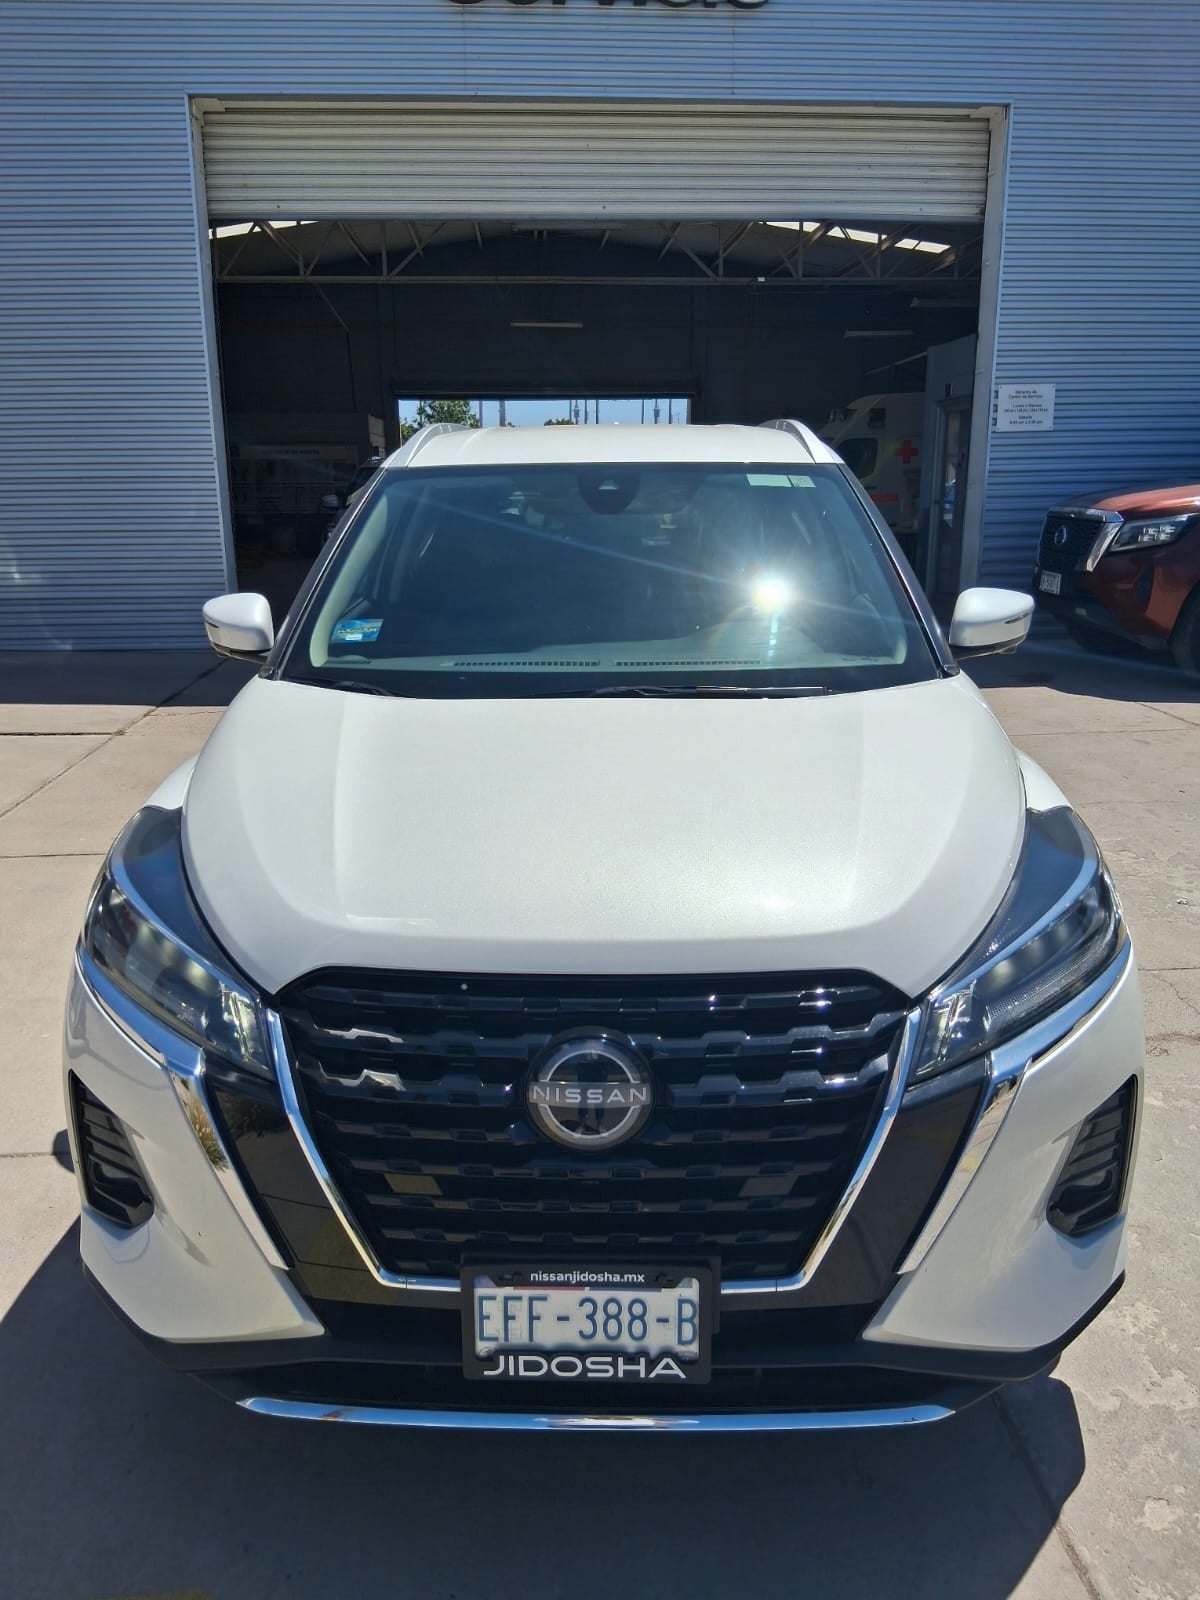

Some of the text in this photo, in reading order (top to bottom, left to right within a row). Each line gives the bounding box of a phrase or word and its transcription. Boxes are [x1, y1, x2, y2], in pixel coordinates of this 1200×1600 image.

[532, 1085, 647, 1104] NISSAN
[530, 1270, 645, 1283] nissanjidosha.mx
[478, 1295, 698, 1345] EFF-388-B
[483, 1355, 686, 1378] JIDOSHA
